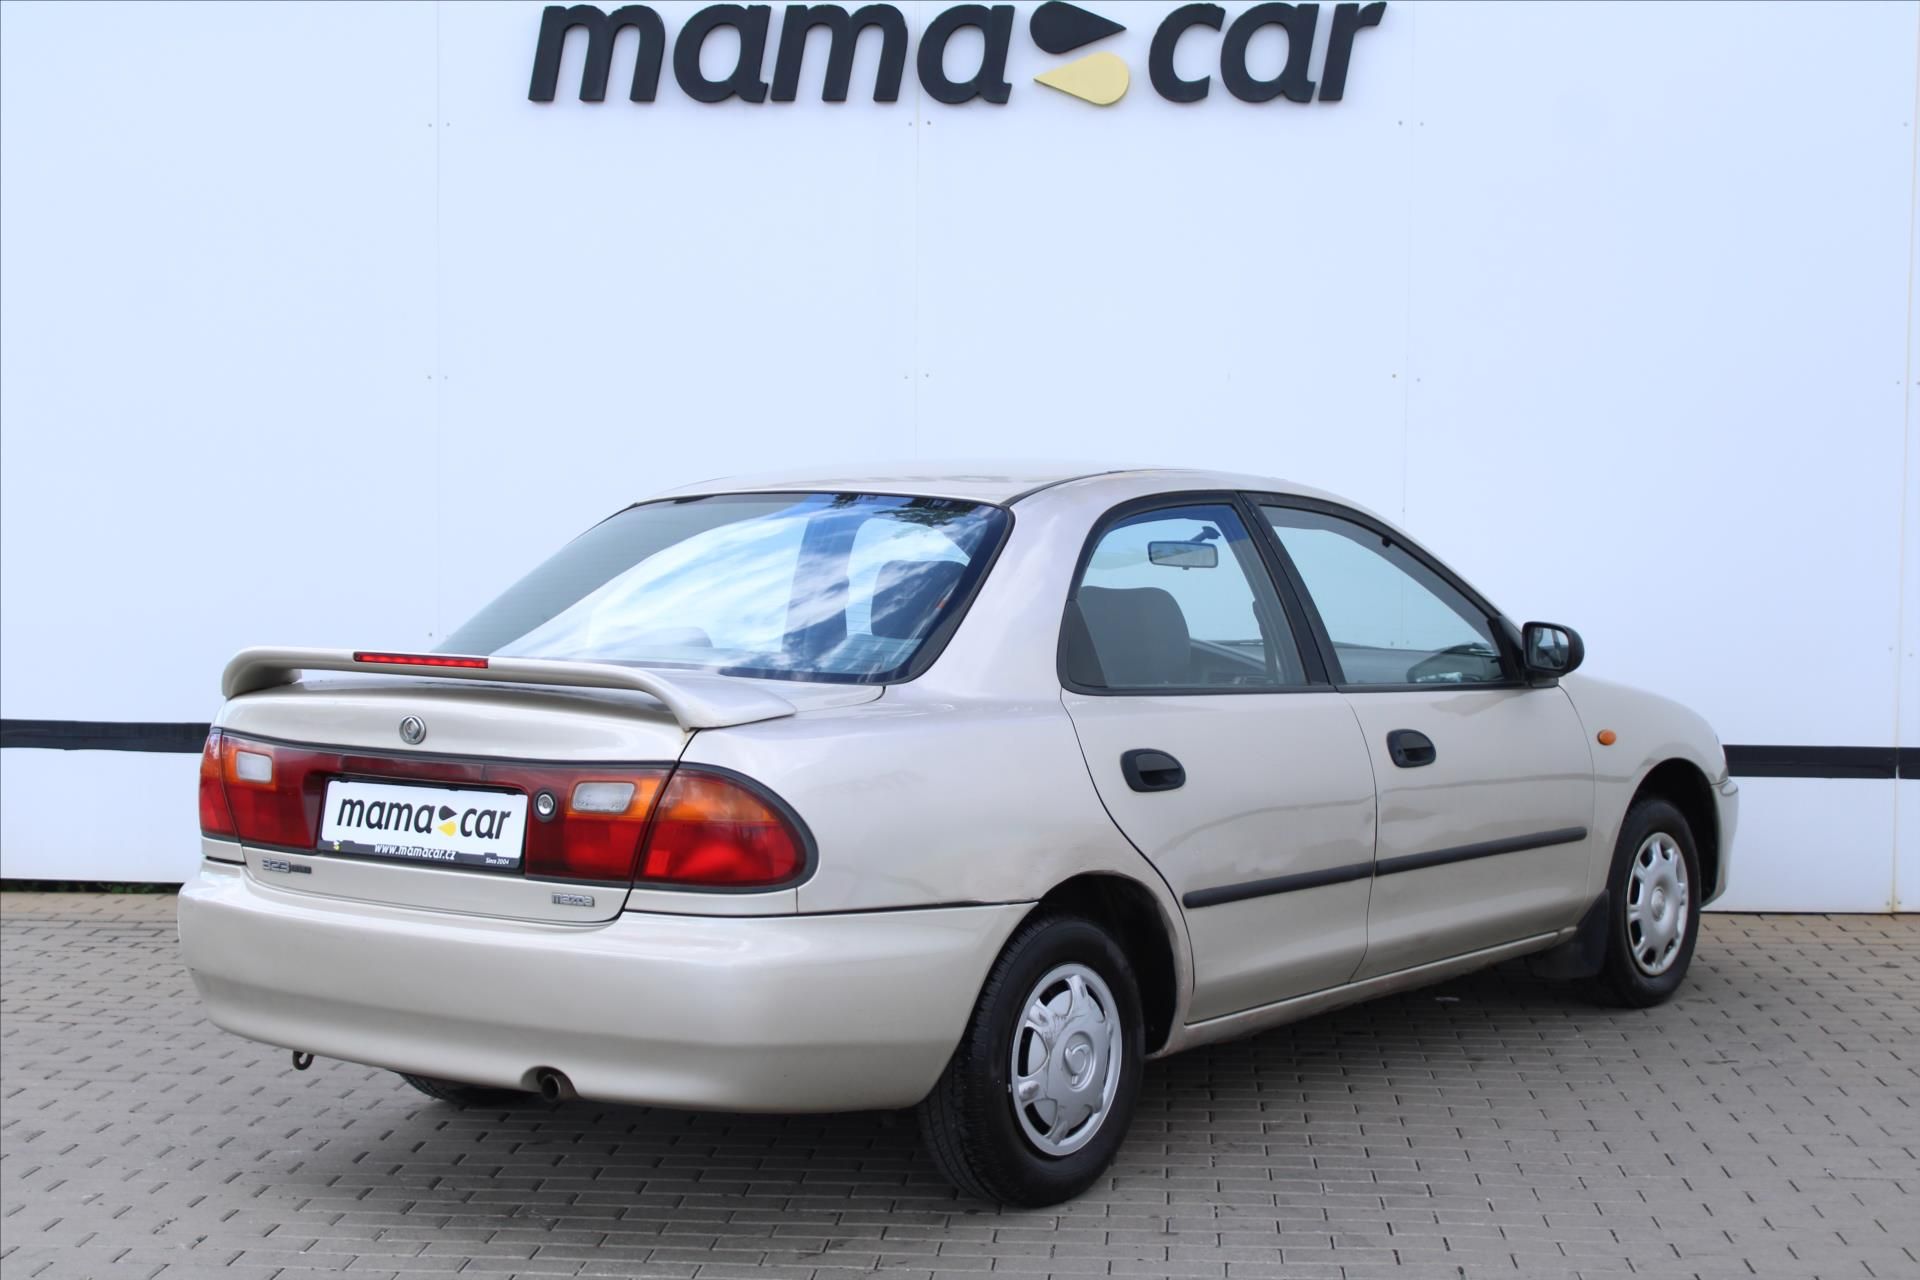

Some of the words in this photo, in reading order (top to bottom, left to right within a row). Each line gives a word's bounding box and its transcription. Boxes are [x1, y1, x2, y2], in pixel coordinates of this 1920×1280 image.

[527, 3, 1012, 104] mama
[1148, 1, 1387, 104] car
[337, 798, 435, 834] mama
[460, 808, 511, 840] car
[374, 843, 456, 861] www.mamacar.cz
[263, 858, 290, 873] 323
[497, 858, 510, 866] 2004
